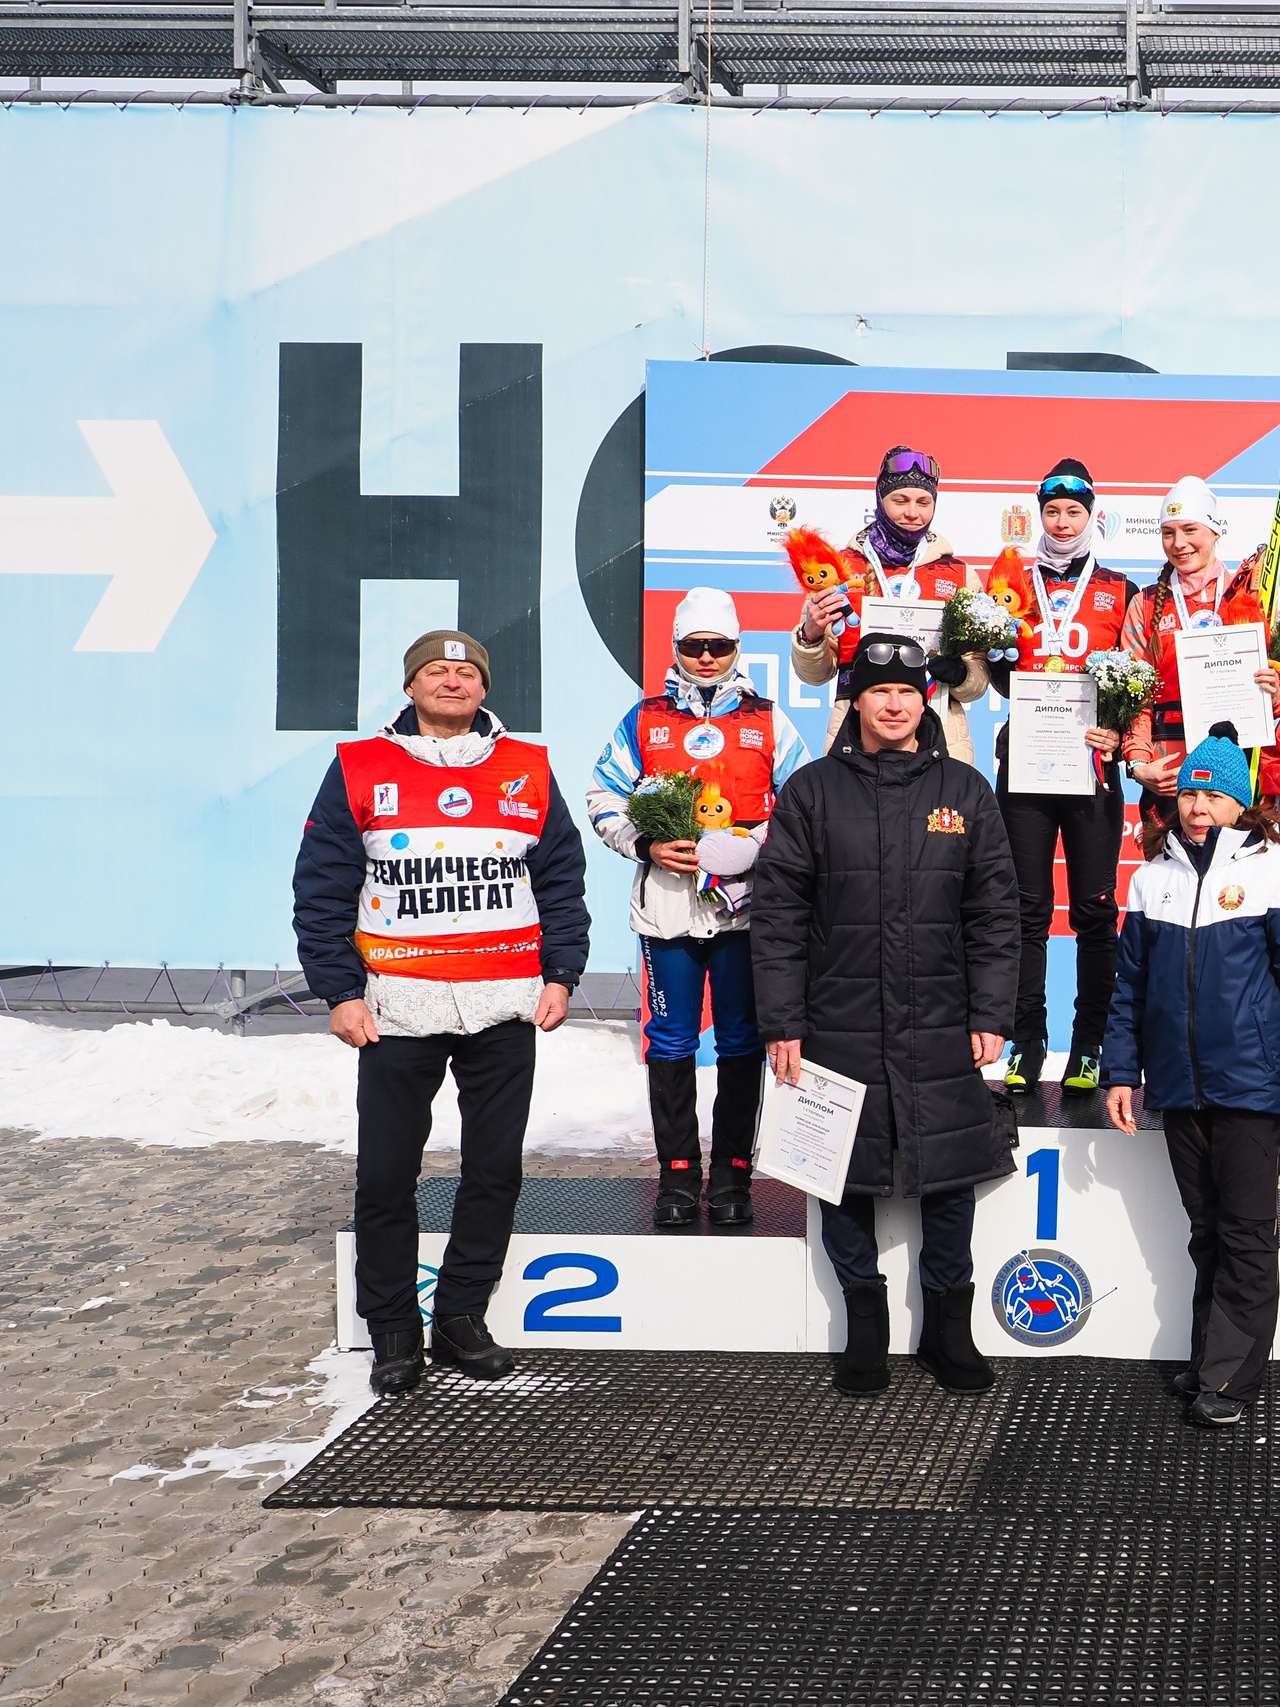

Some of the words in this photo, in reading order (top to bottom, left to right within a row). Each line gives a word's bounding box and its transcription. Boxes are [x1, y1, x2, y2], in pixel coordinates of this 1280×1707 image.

[1033, 622, 1089, 658] 10
[1204, 659, 1242, 669] ДИПЛОМ
[1035, 705, 1072, 713] ДИПЛОМ
[397, 882, 514, 919] ДЕЛЕГАТ
[798, 1096, 834, 1116] ДИПЛОМ
[1026, 1148, 1060, 1241] 1
[523, 1252, 622, 1332] 2
[994, 1256, 1021, 1304] АКАДЕМИЯ
[1057, 1255, 1091, 1300] БИАТЛОНА
[1013, 1329, 1061, 1344] КРАСНОЯРСКИЙ
[1061, 1325, 1076, 1342] КРАЙ
